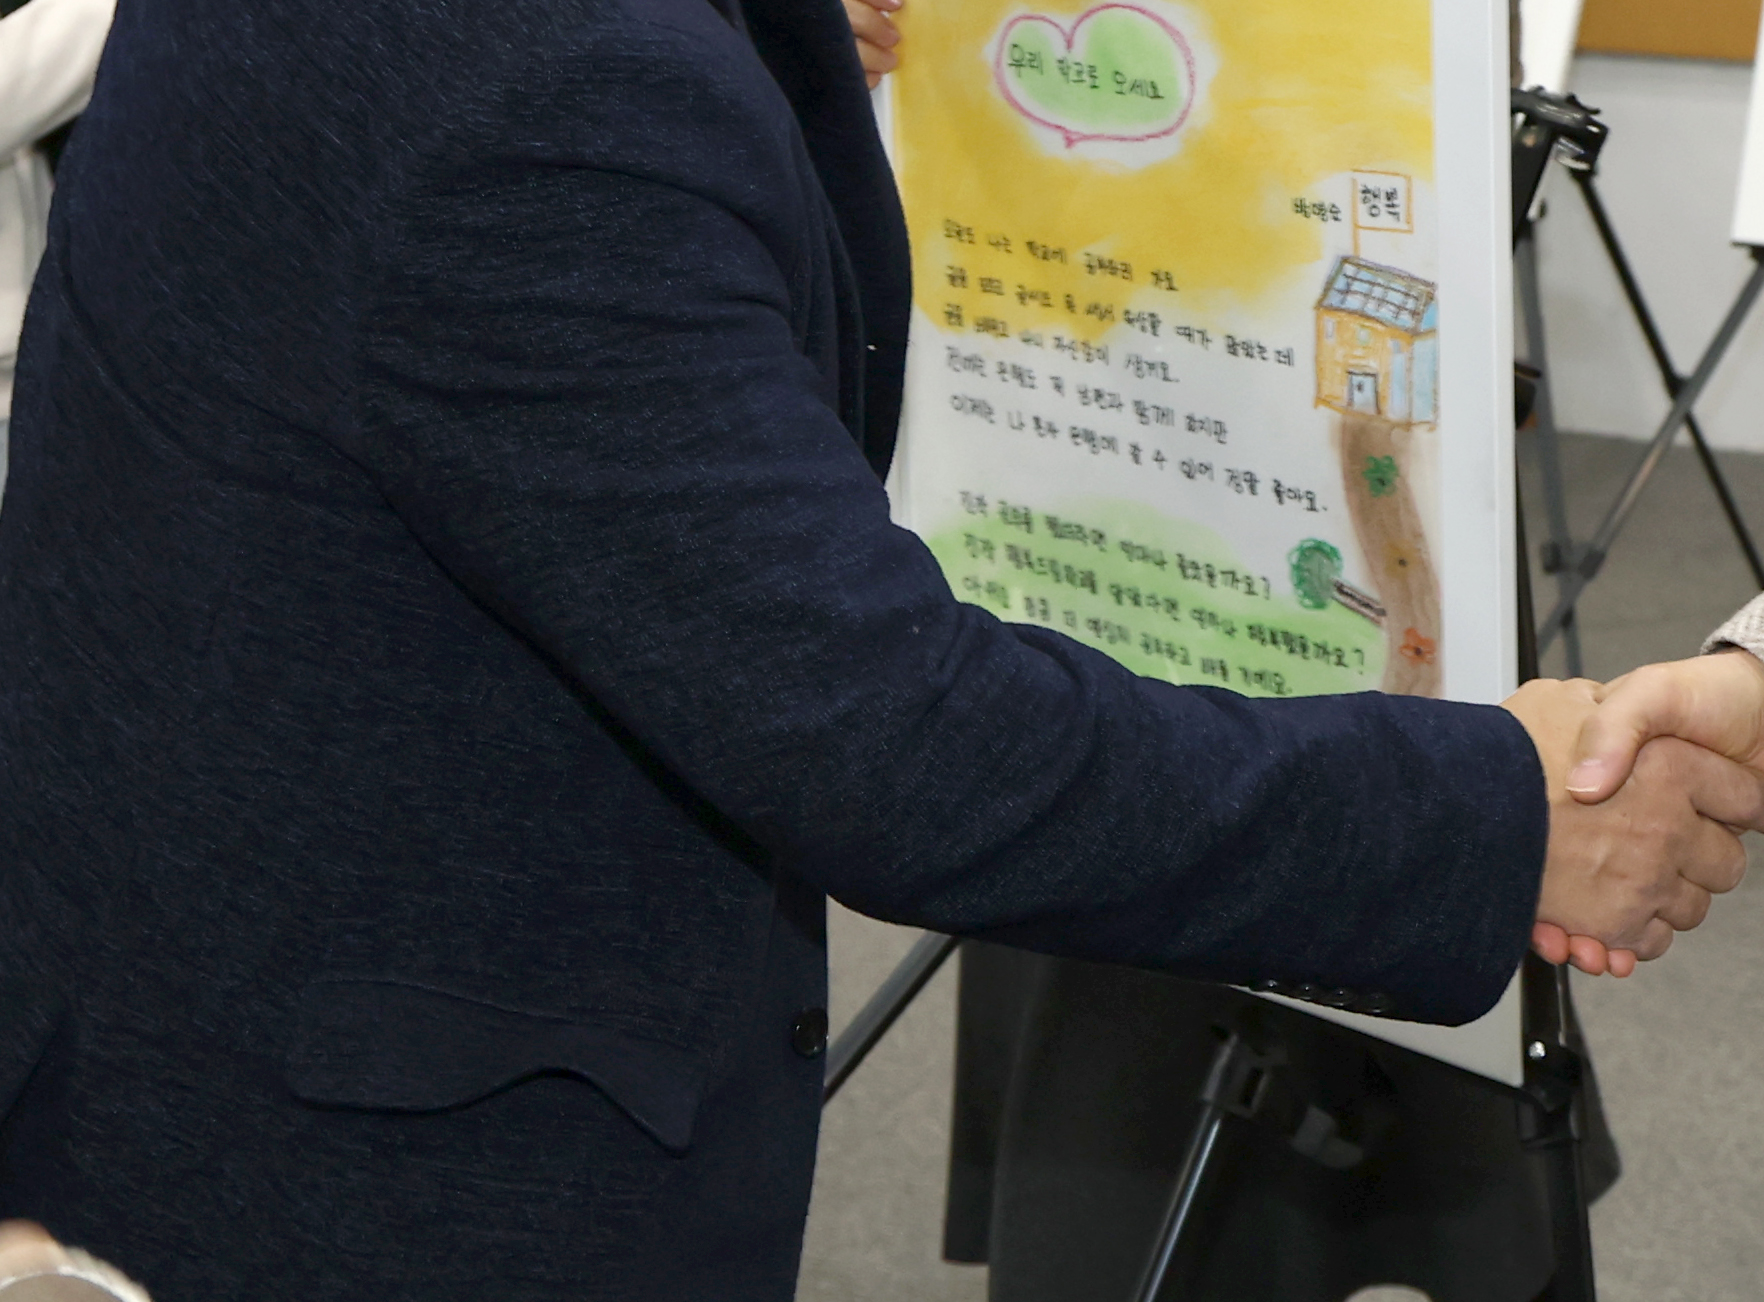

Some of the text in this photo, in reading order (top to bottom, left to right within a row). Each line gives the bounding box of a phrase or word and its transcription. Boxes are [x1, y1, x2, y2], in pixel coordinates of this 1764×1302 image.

[1008, 43, 1164, 99] 우리 학교로 오세요
[1175, 325, 1212, 350] 때가
[1008, 411, 1025, 430] 나
[1152, 449, 1167, 470] 수
[1224, 467, 1260, 495] 정말
